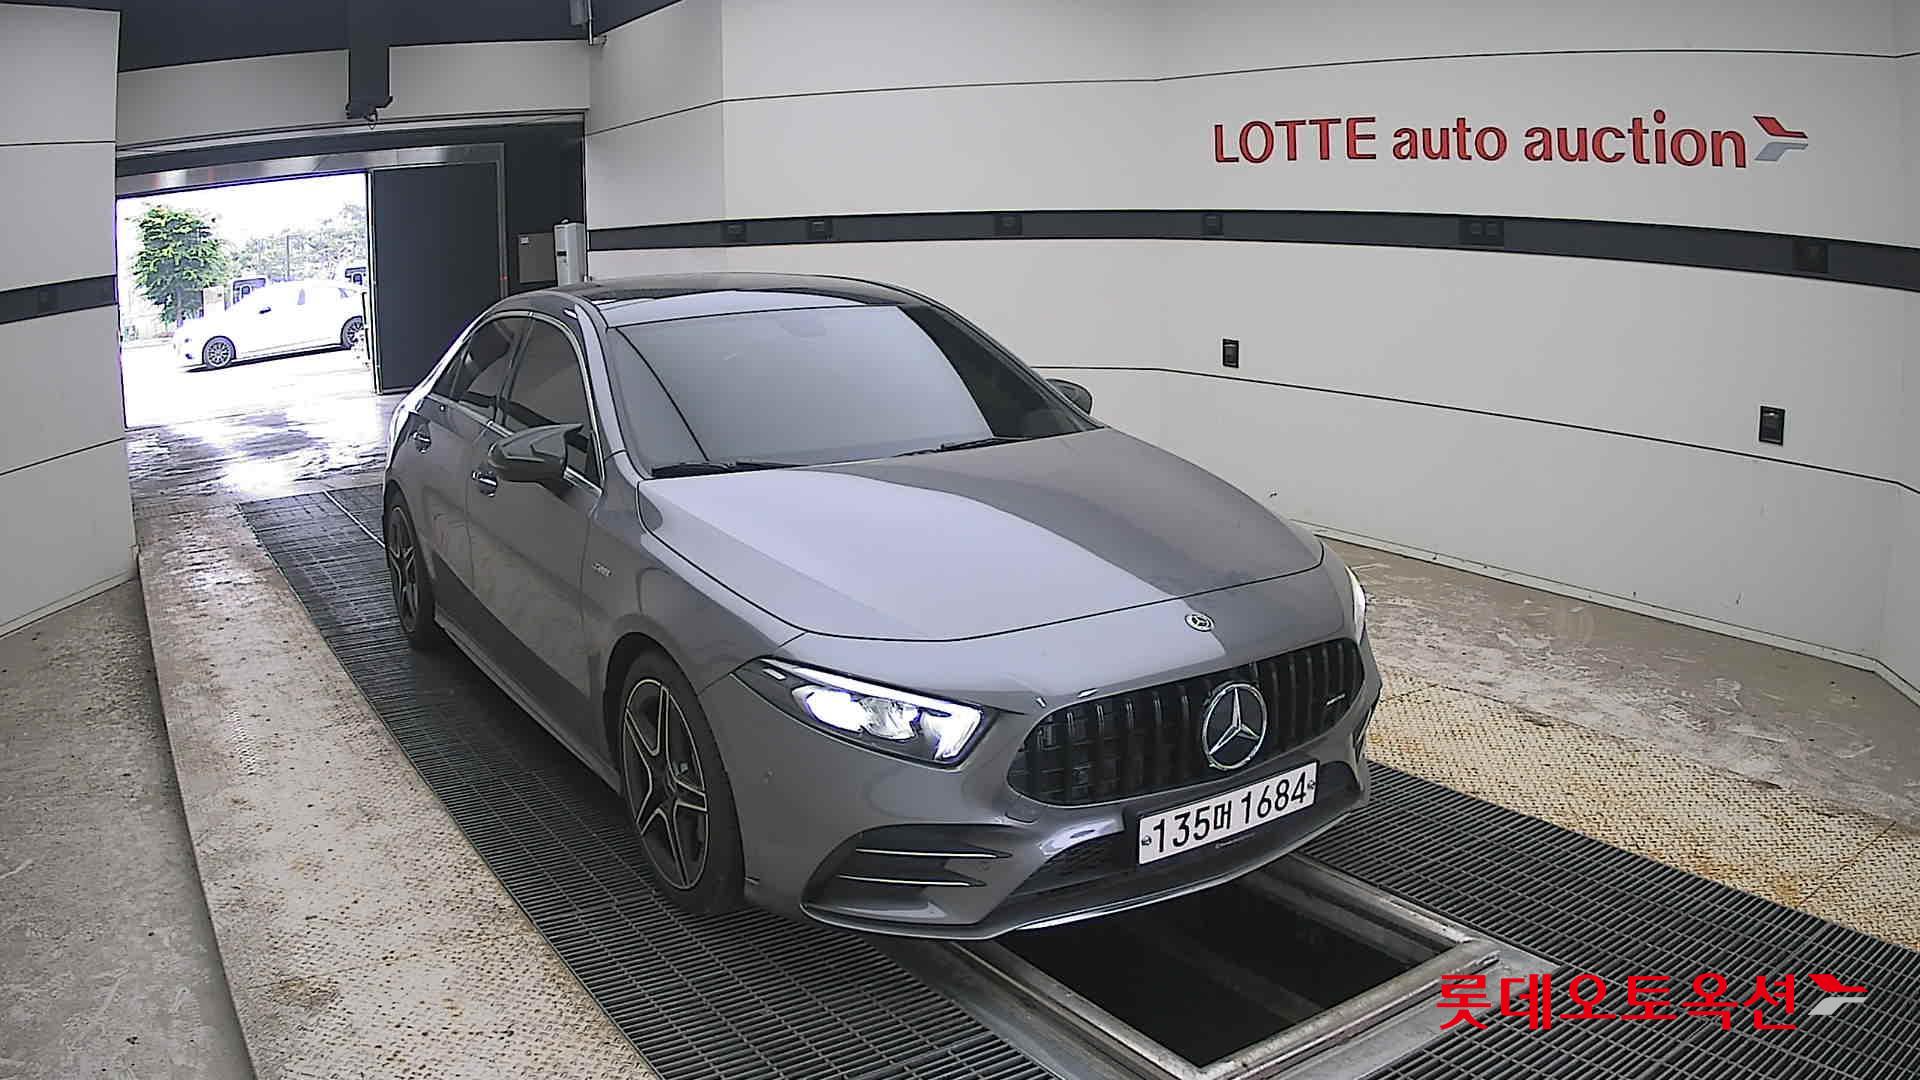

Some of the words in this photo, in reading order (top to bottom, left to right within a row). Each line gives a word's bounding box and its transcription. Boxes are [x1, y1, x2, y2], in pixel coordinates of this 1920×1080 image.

[1213, 116, 1377, 163] LOTTE
[1392, 117, 1508, 162] auto
[1523, 109, 1747, 168] auction
[1152, 800, 1232, 853] 135머
[1241, 772, 1307, 824] 1684
